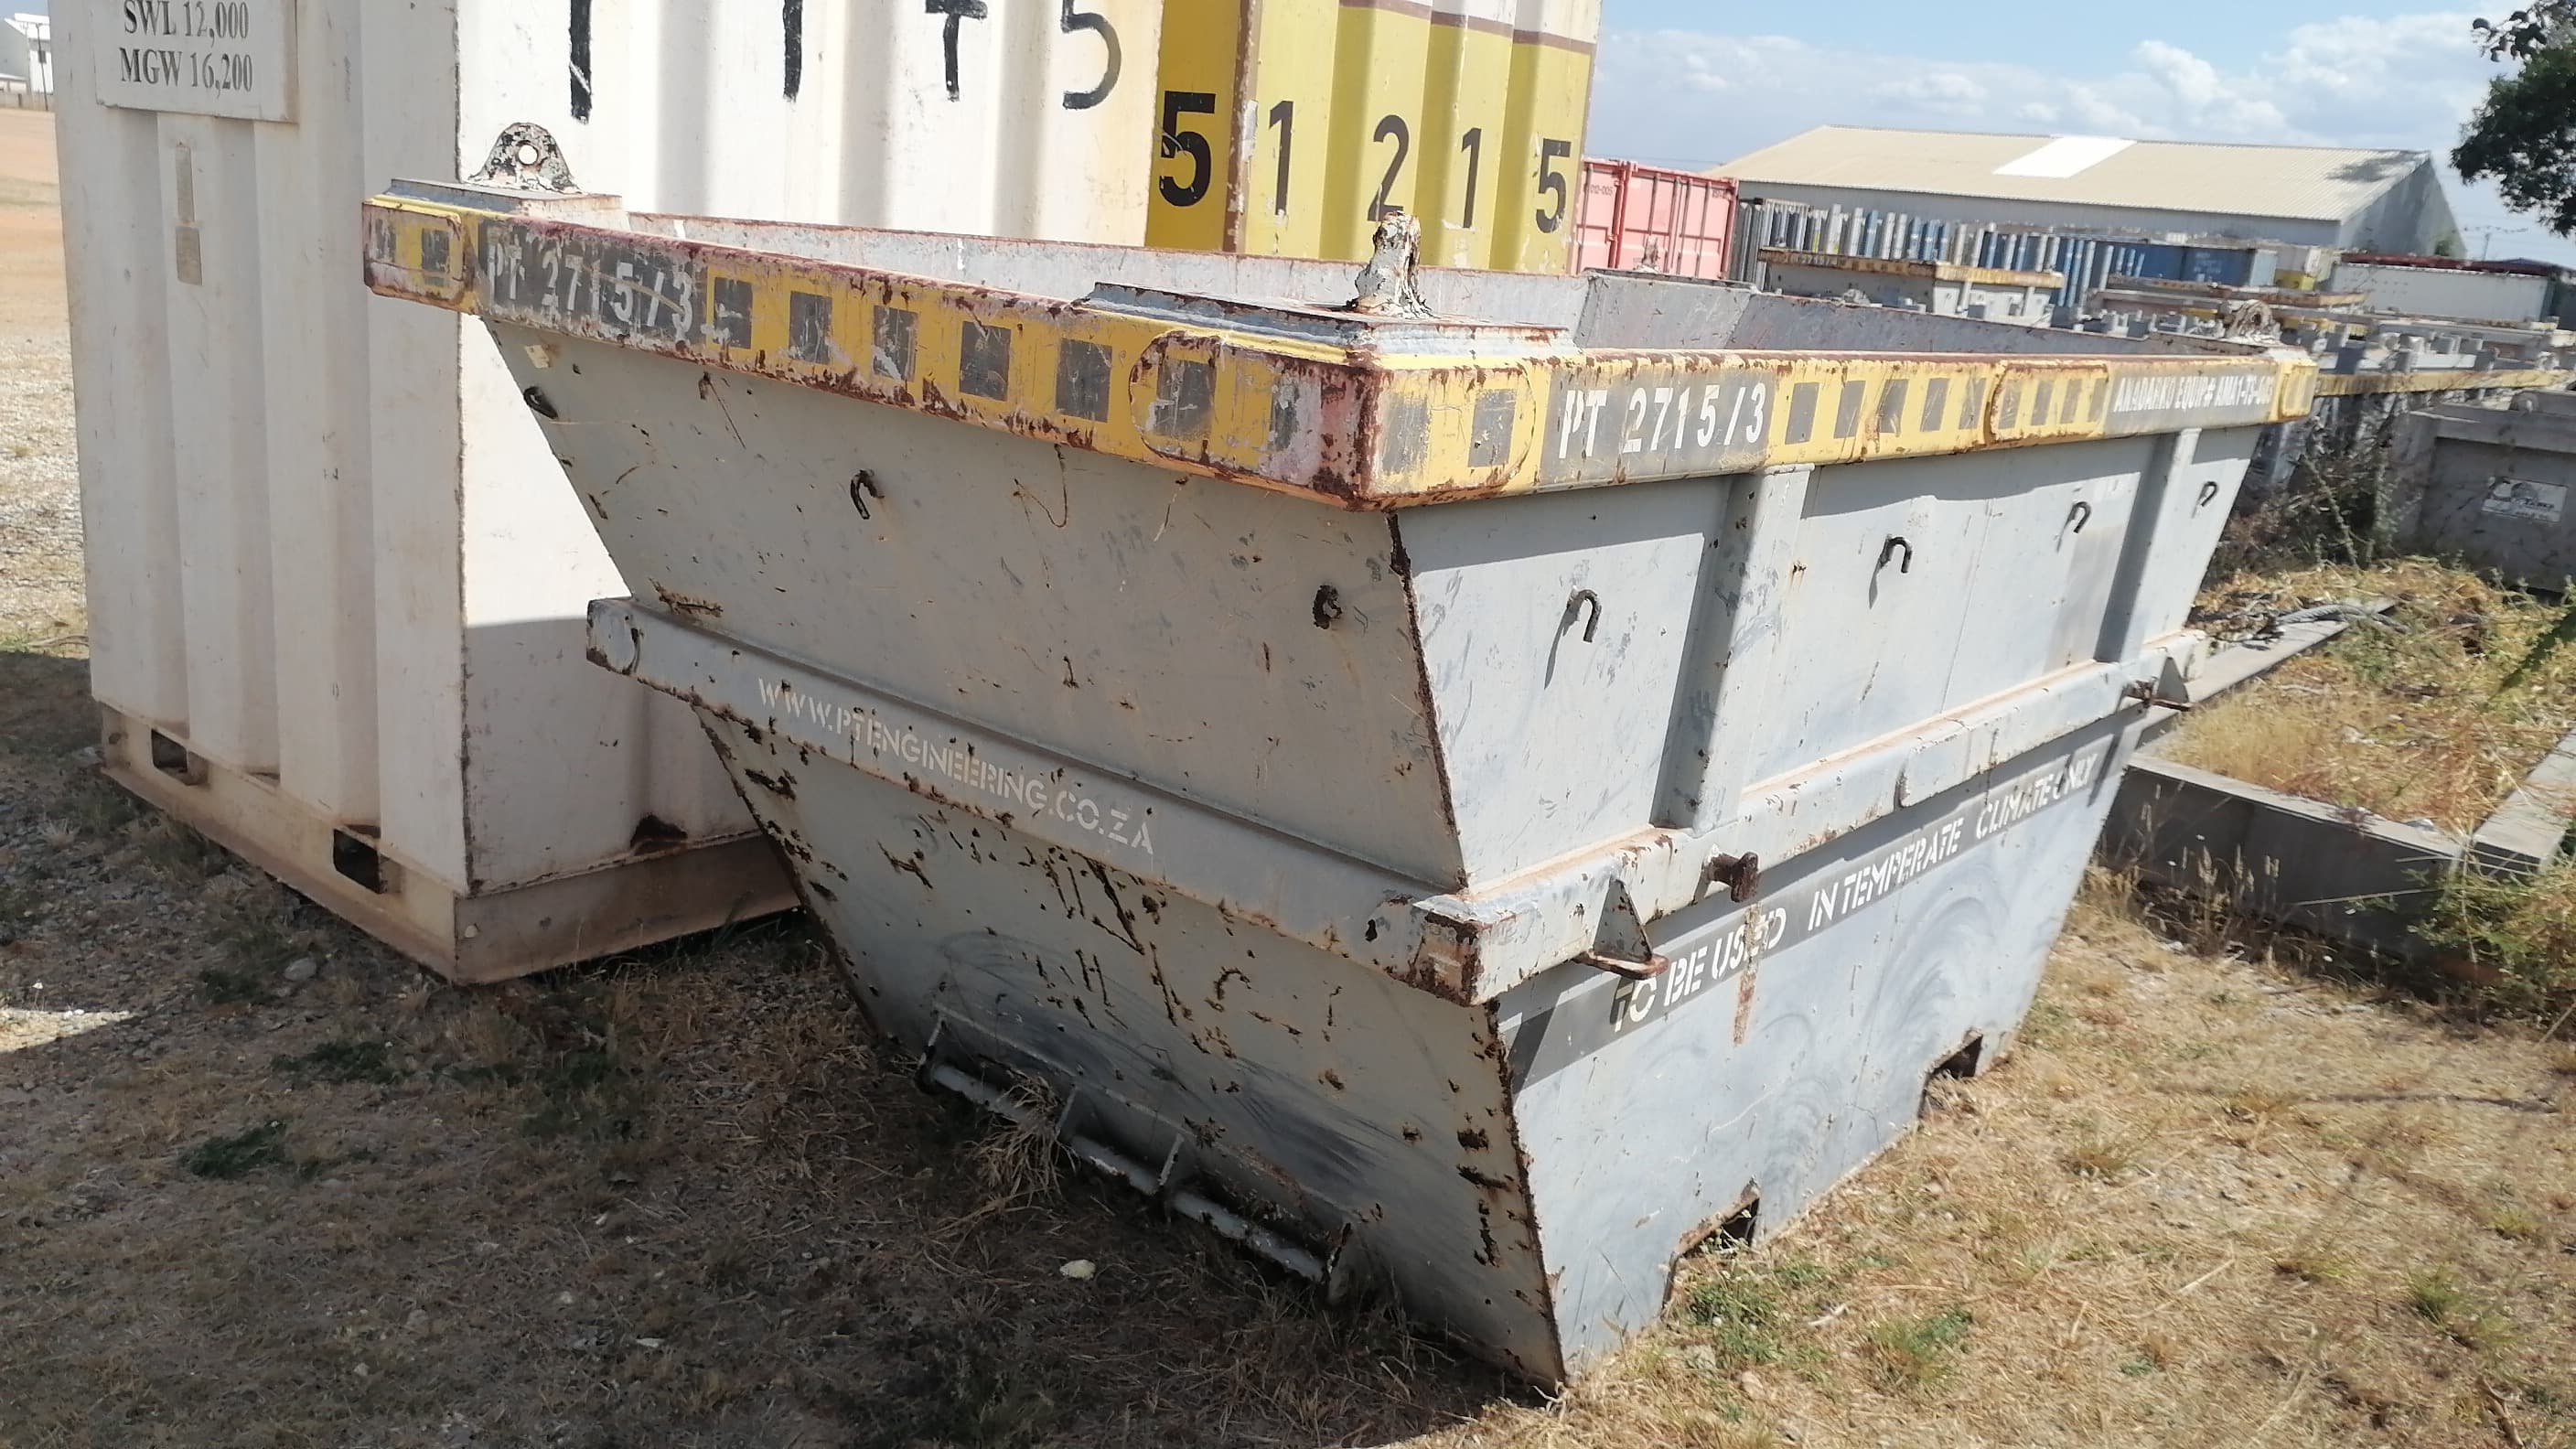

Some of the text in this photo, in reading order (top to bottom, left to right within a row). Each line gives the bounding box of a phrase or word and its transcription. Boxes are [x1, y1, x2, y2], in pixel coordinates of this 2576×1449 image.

[123, 0, 249, 48] SWL 12,000
[119, 47, 252, 99] MGW 16,200
[1159, 91, 1215, 207] 5
[1559, 382, 1766, 458] PT 2715/3
[758, 678, 1155, 854] WWW.PTENGINEERING.CO.ZA
[1614, 974, 1658, 1033] TO
[1663, 946, 1709, 1006] BE
[1711, 907, 1787, 980] USED
[1808, 882, 1839, 931] IN
[1841, 817, 1965, 915] TEMPERATE
